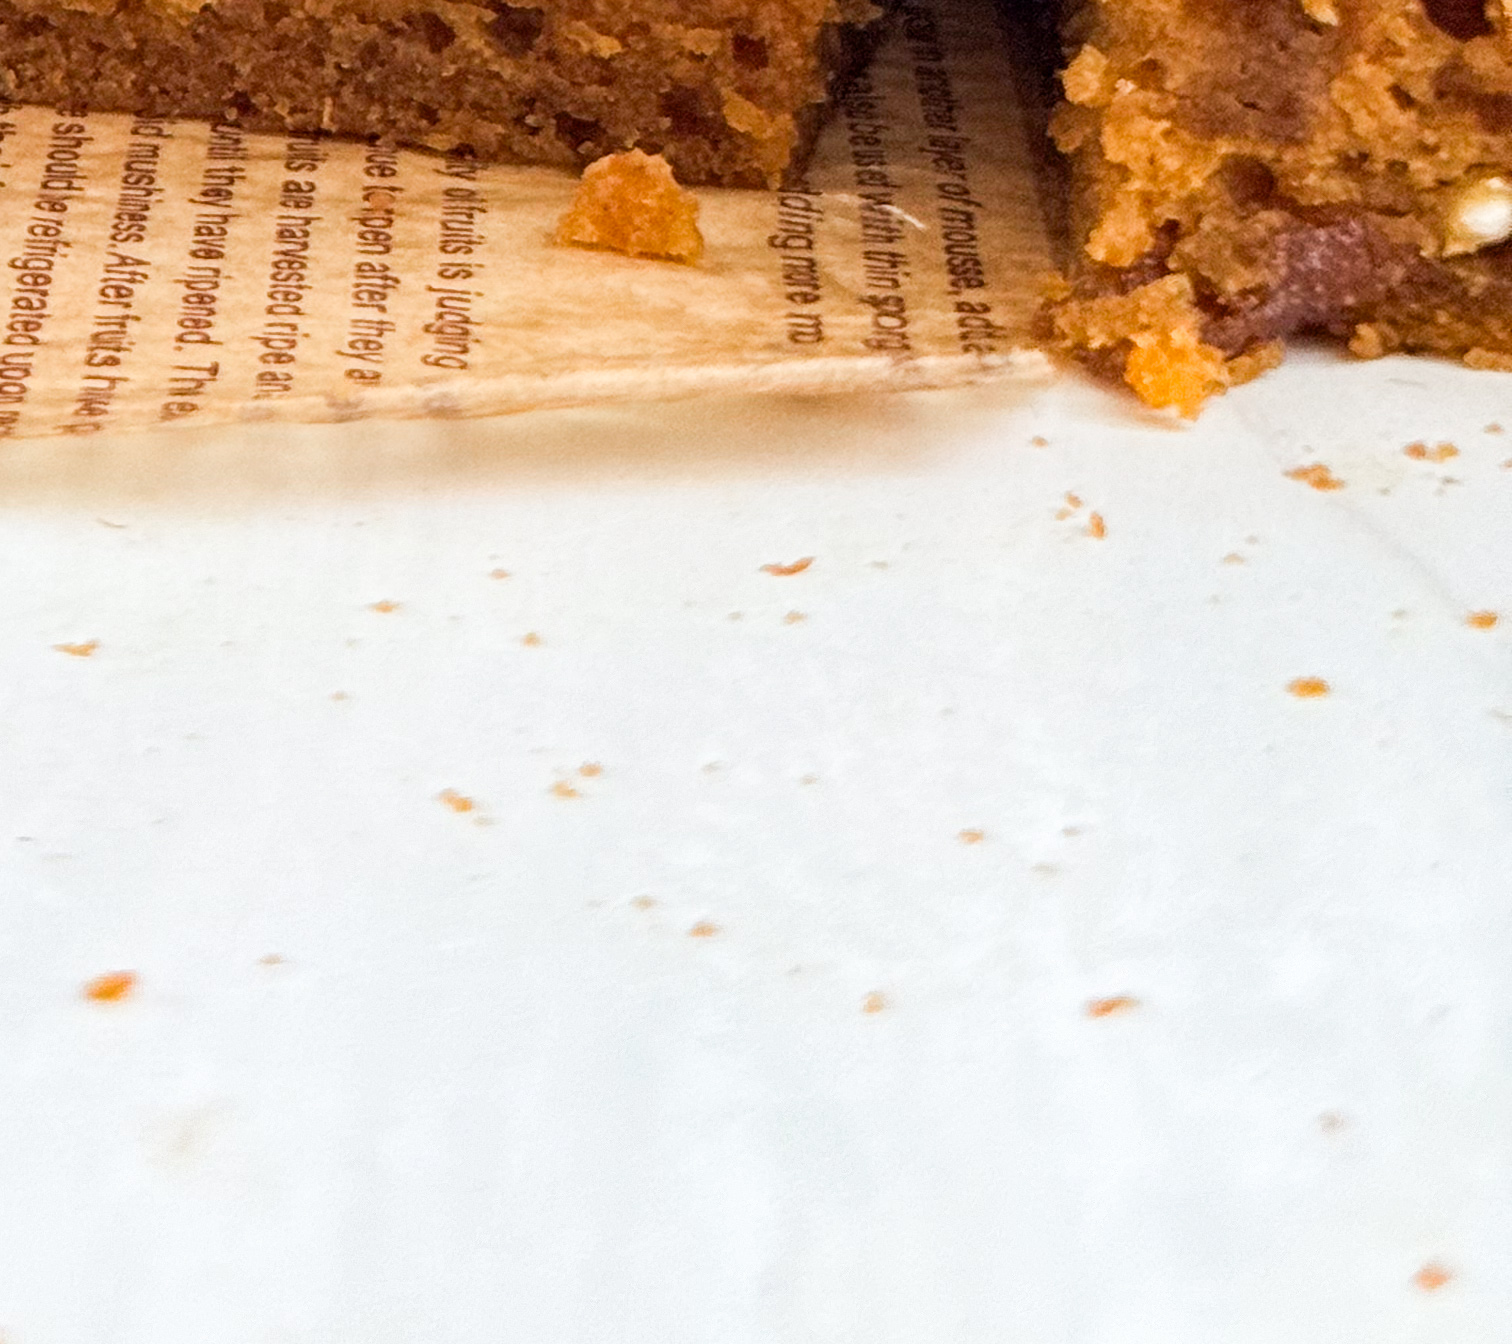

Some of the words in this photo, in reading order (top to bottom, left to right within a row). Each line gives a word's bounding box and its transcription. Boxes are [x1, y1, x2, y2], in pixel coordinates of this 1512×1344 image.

[40, 122, 95, 192] should
[918, 134, 971, 182] layer
[107, 142, 165, 248] mushiness.
[188, 165, 247, 208] they
[279, 179, 317, 210] are
[937, 182, 983, 208] of
[189, 212, 242, 260] have
[439, 205, 488, 255] fruits
[939, 207, 985, 296] mousse,
[2, 216, 73, 346] refrigerated
[98, 250, 152, 309] After
[265, 214, 323, 316] harvested
[352, 261, 401, 313] after
[438, 262, 485, 280] is
[862, 249, 912, 289] thin
[172, 265, 234, 353] ripened.
[420, 284, 485, 371] judging
[85, 314, 142, 368] fruits
[248, 321, 311, 365] ripe
[335, 318, 396, 363] they
